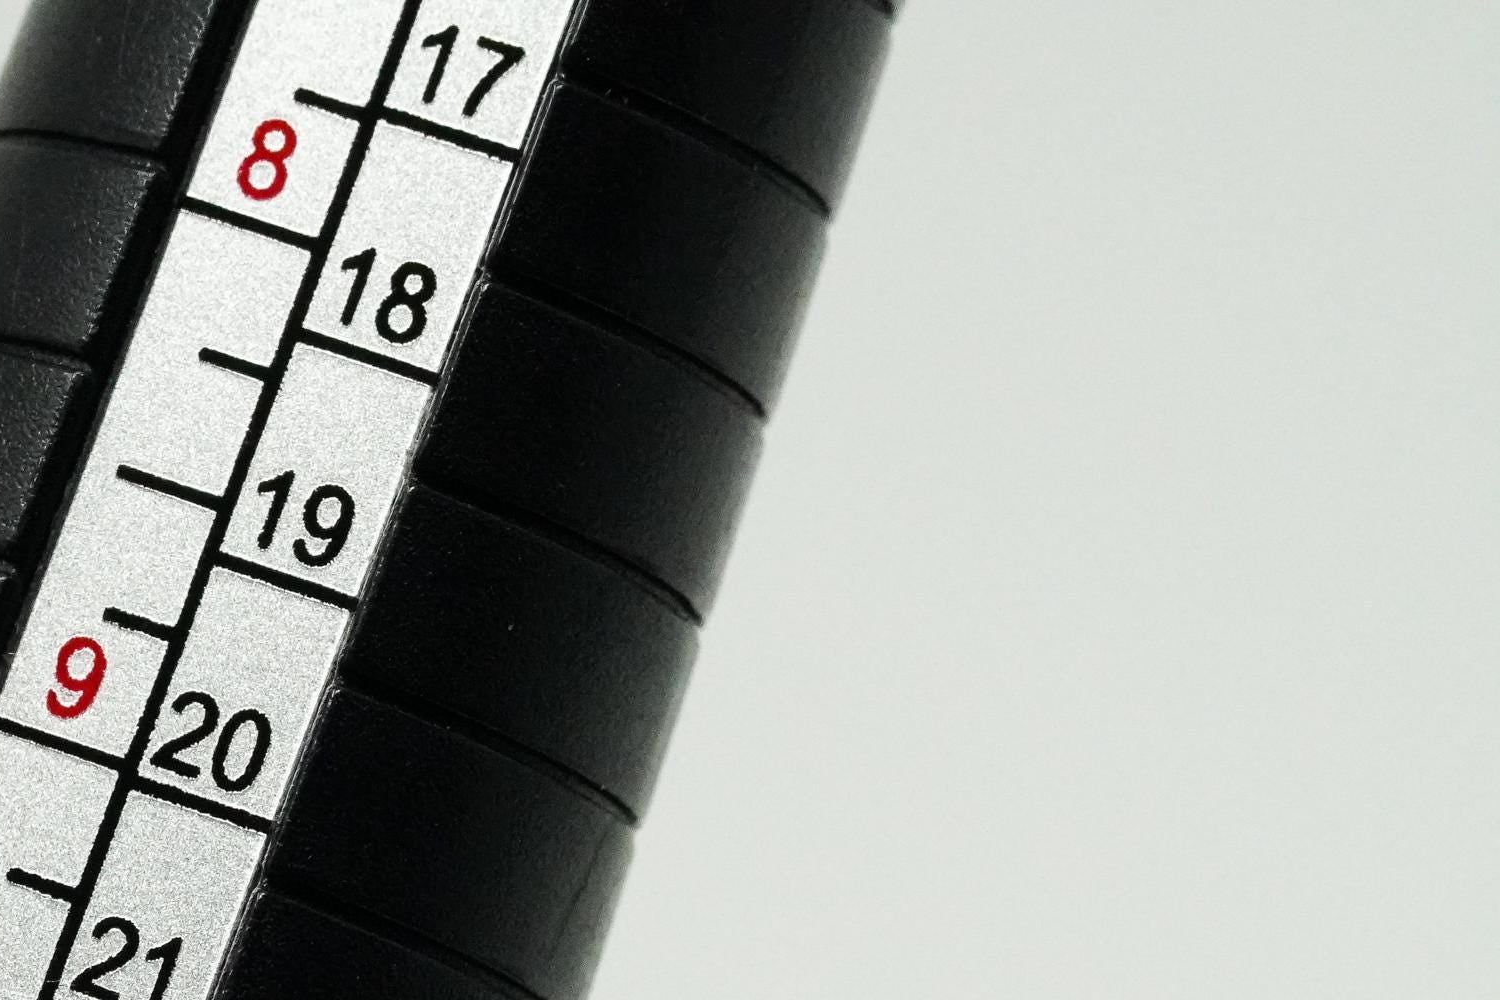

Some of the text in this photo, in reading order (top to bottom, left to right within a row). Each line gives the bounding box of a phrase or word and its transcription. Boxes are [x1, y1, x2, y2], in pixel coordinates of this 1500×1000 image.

[422, 26, 525, 117] 17
[237, 119, 296, 200] 8
[340, 248, 436, 344] 18
[258, 470, 355, 567] 19
[47, 637, 107, 719] 9
[150, 691, 272, 792] 20
